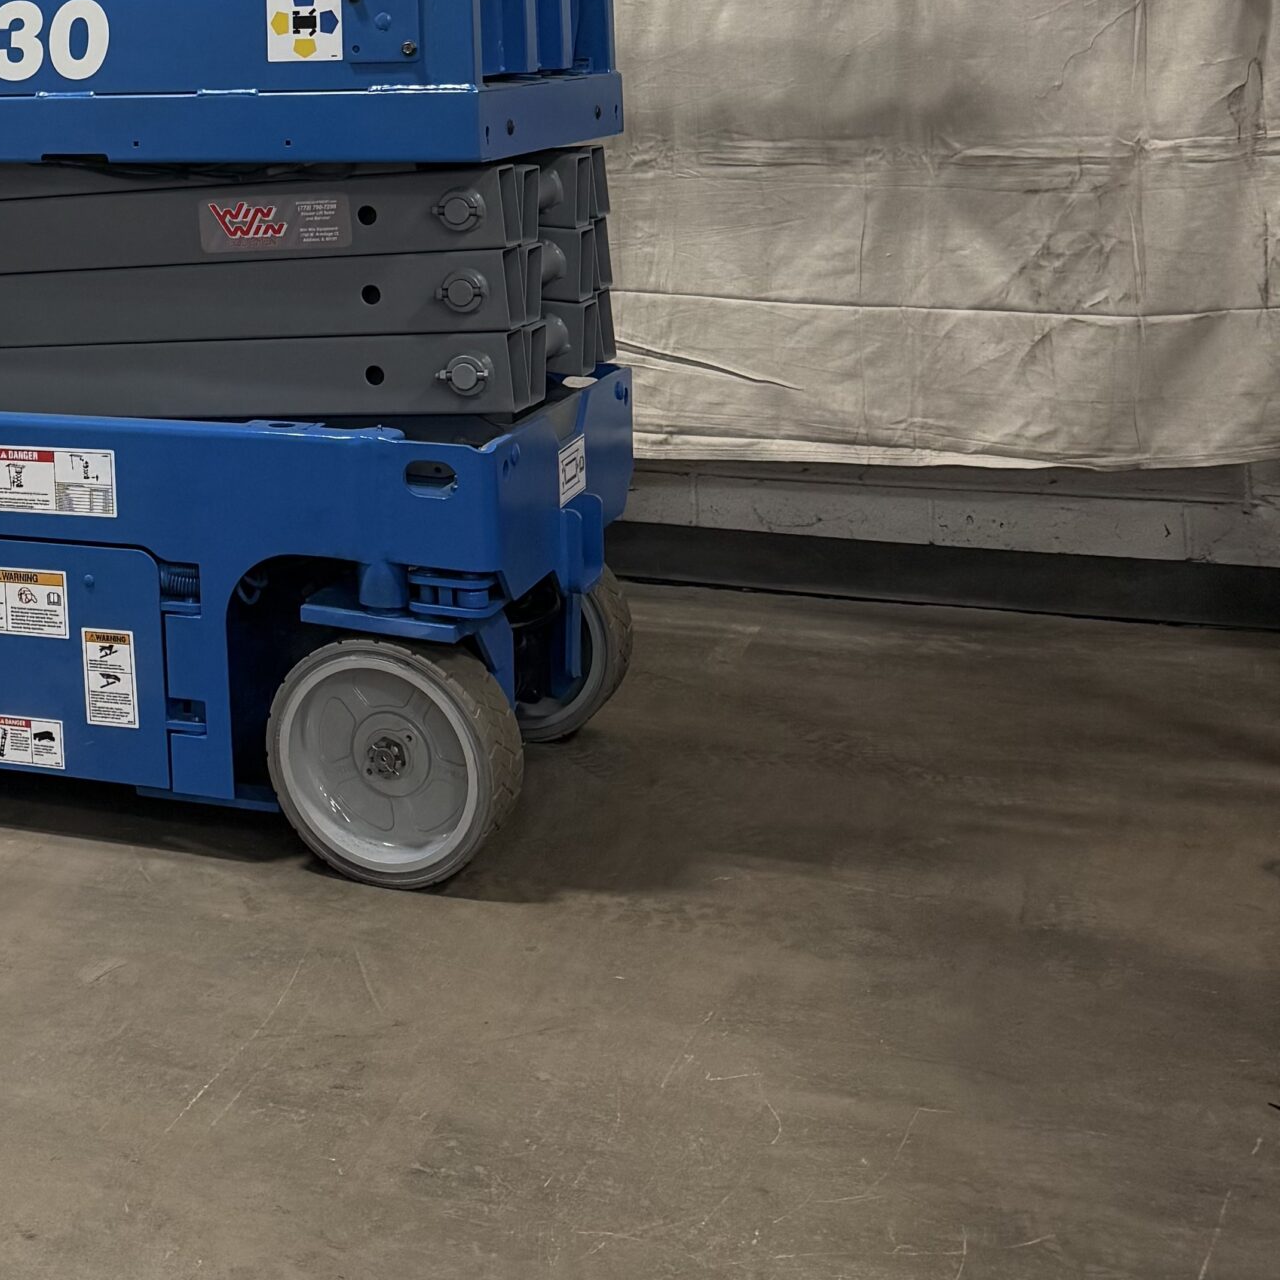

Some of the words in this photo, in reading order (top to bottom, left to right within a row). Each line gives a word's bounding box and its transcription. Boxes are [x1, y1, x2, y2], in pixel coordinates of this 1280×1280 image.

[8, 450, 39, 460] DANGER
[3, 572, 39, 583] WARNING
[95, 634, 126, 643] WARNING
[6, 718, 26, 726] DANGER
